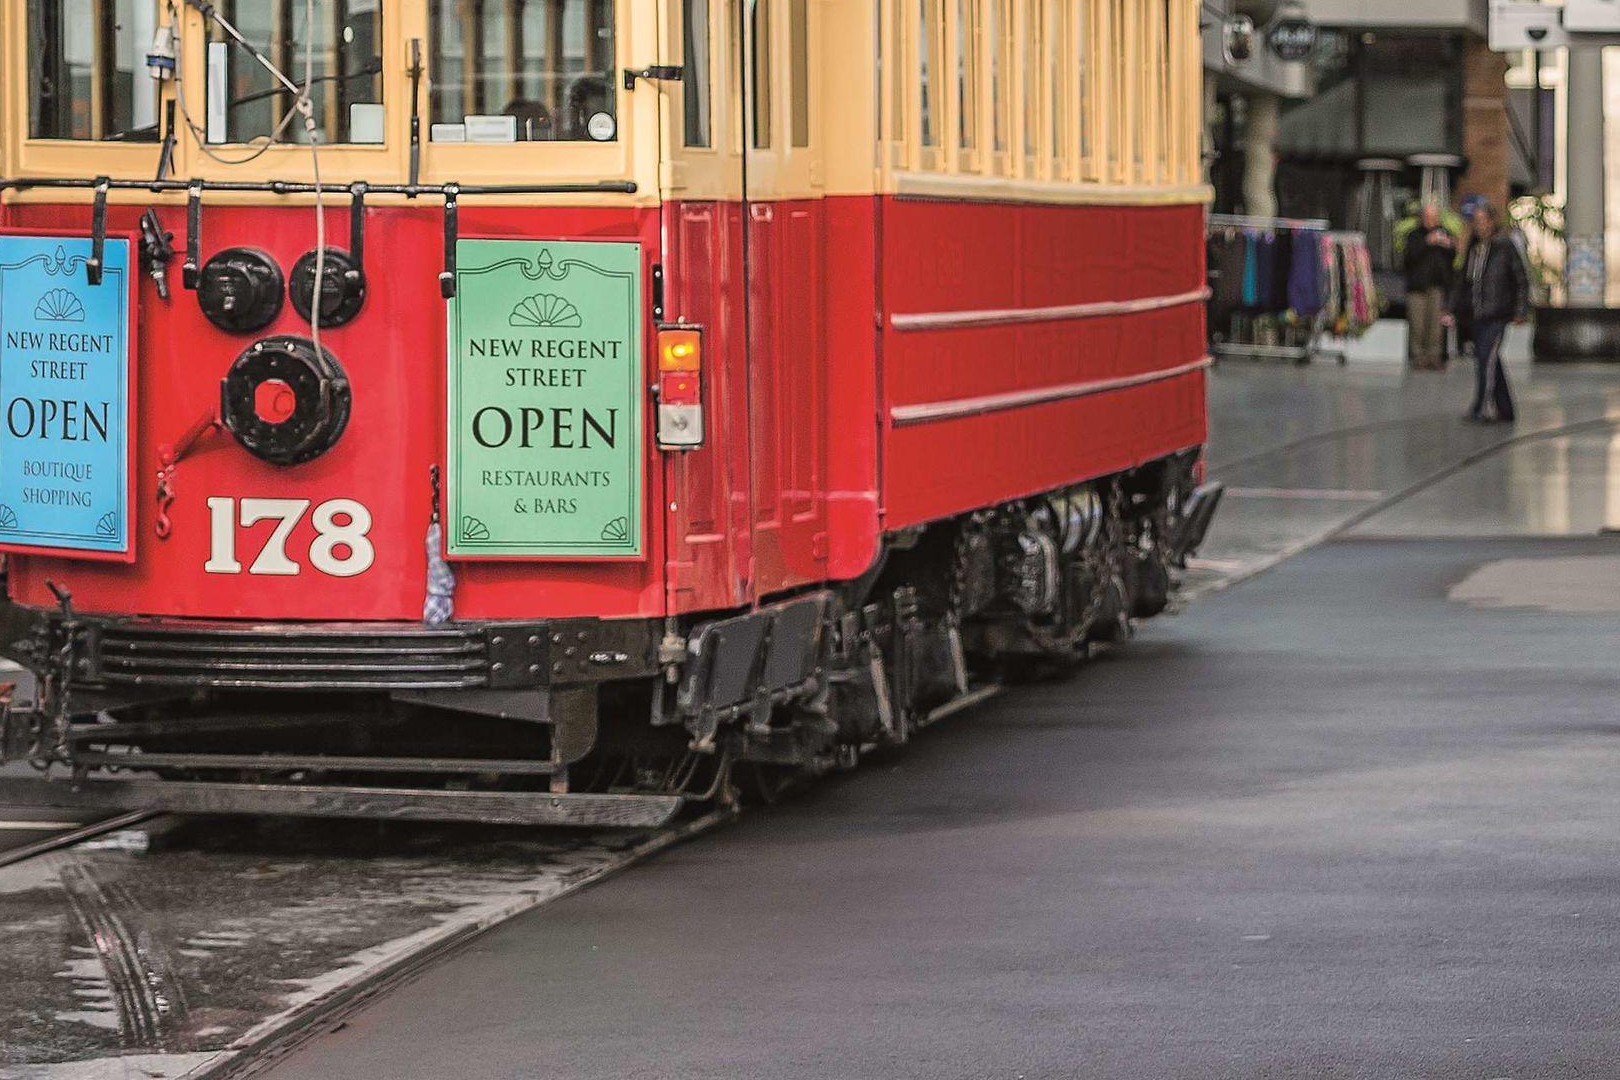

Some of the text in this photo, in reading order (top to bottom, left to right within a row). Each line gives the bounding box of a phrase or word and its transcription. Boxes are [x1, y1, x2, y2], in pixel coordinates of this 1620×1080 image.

[6, 331, 113, 354] NEW REGENT
[469, 338, 623, 360] NEW REGENT
[30, 360, 88, 381] STREET
[505, 368, 587, 388] STREET
[6, 397, 111, 443] OPEN
[471, 406, 619, 450] OPEN
[23, 460, 93, 482] BOUTIQUE
[481, 470, 611, 488] RESTAURANTS
[22, 487, 92, 508] SHOPPING
[514, 497, 578, 515] & BARS
[203, 496, 376, 577] 178
